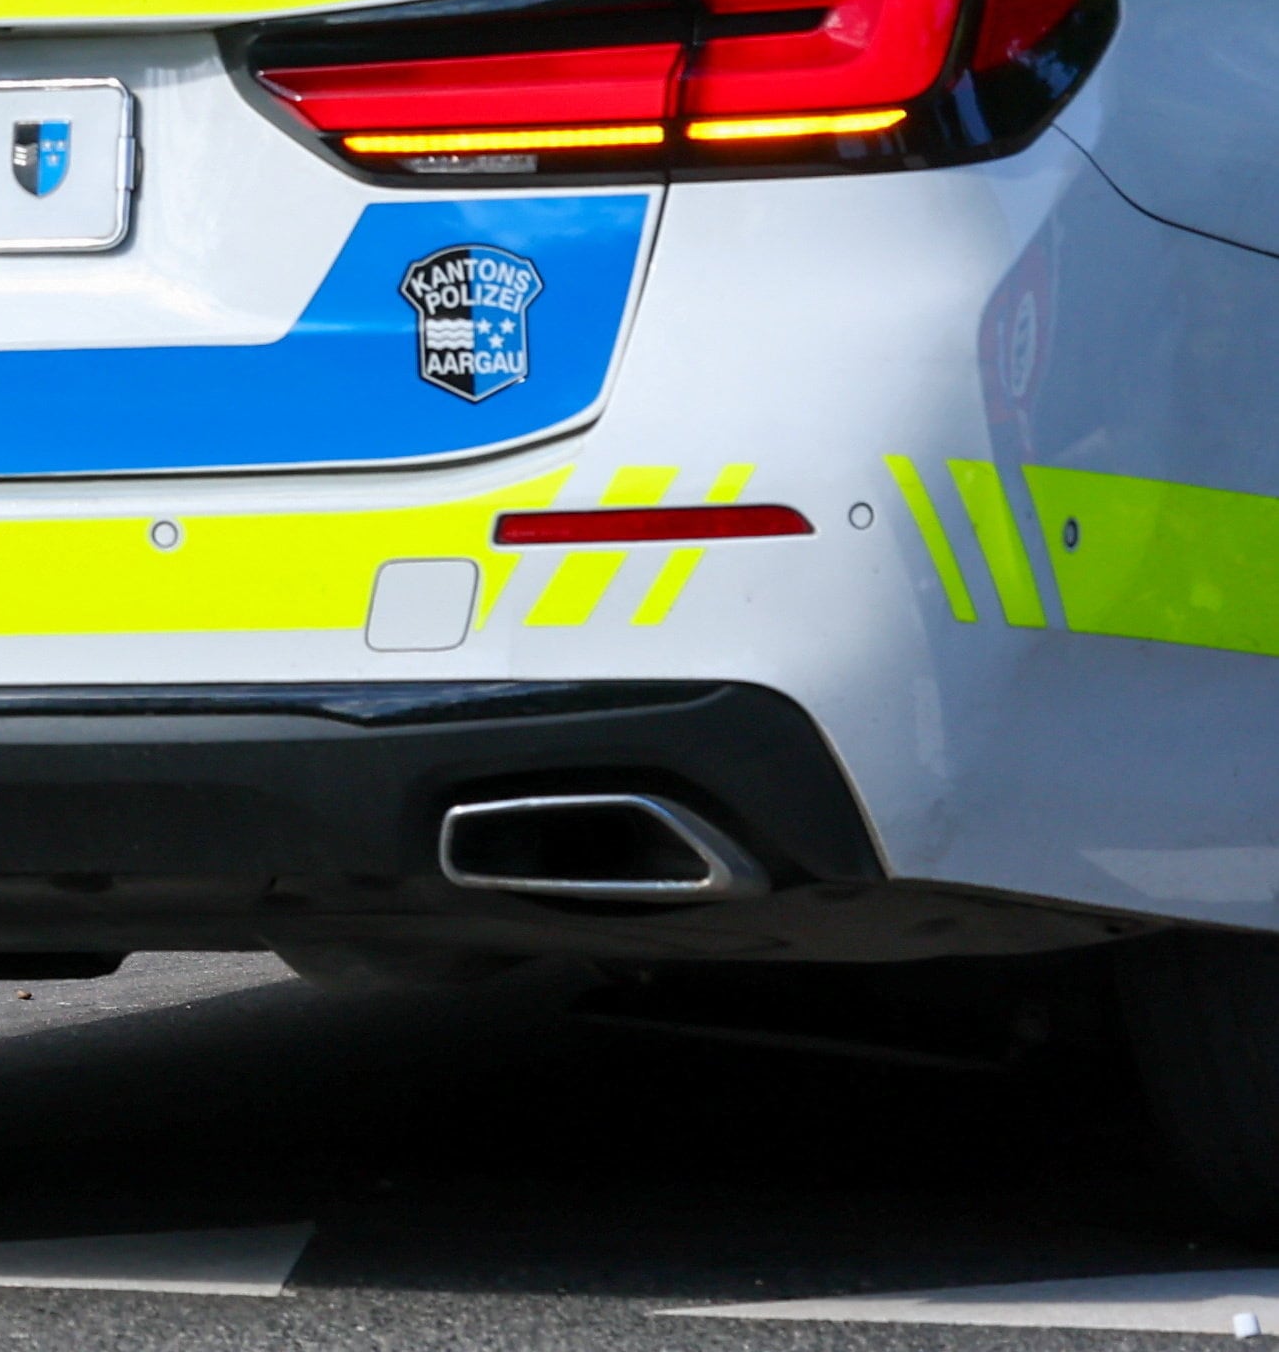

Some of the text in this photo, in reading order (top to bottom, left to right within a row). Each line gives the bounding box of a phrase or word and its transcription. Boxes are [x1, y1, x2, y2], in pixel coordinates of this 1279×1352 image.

[411, 258, 532, 298] KANTONS
[425, 284, 524, 316] POLIZEI
[427, 351, 524, 376] AARGAU
